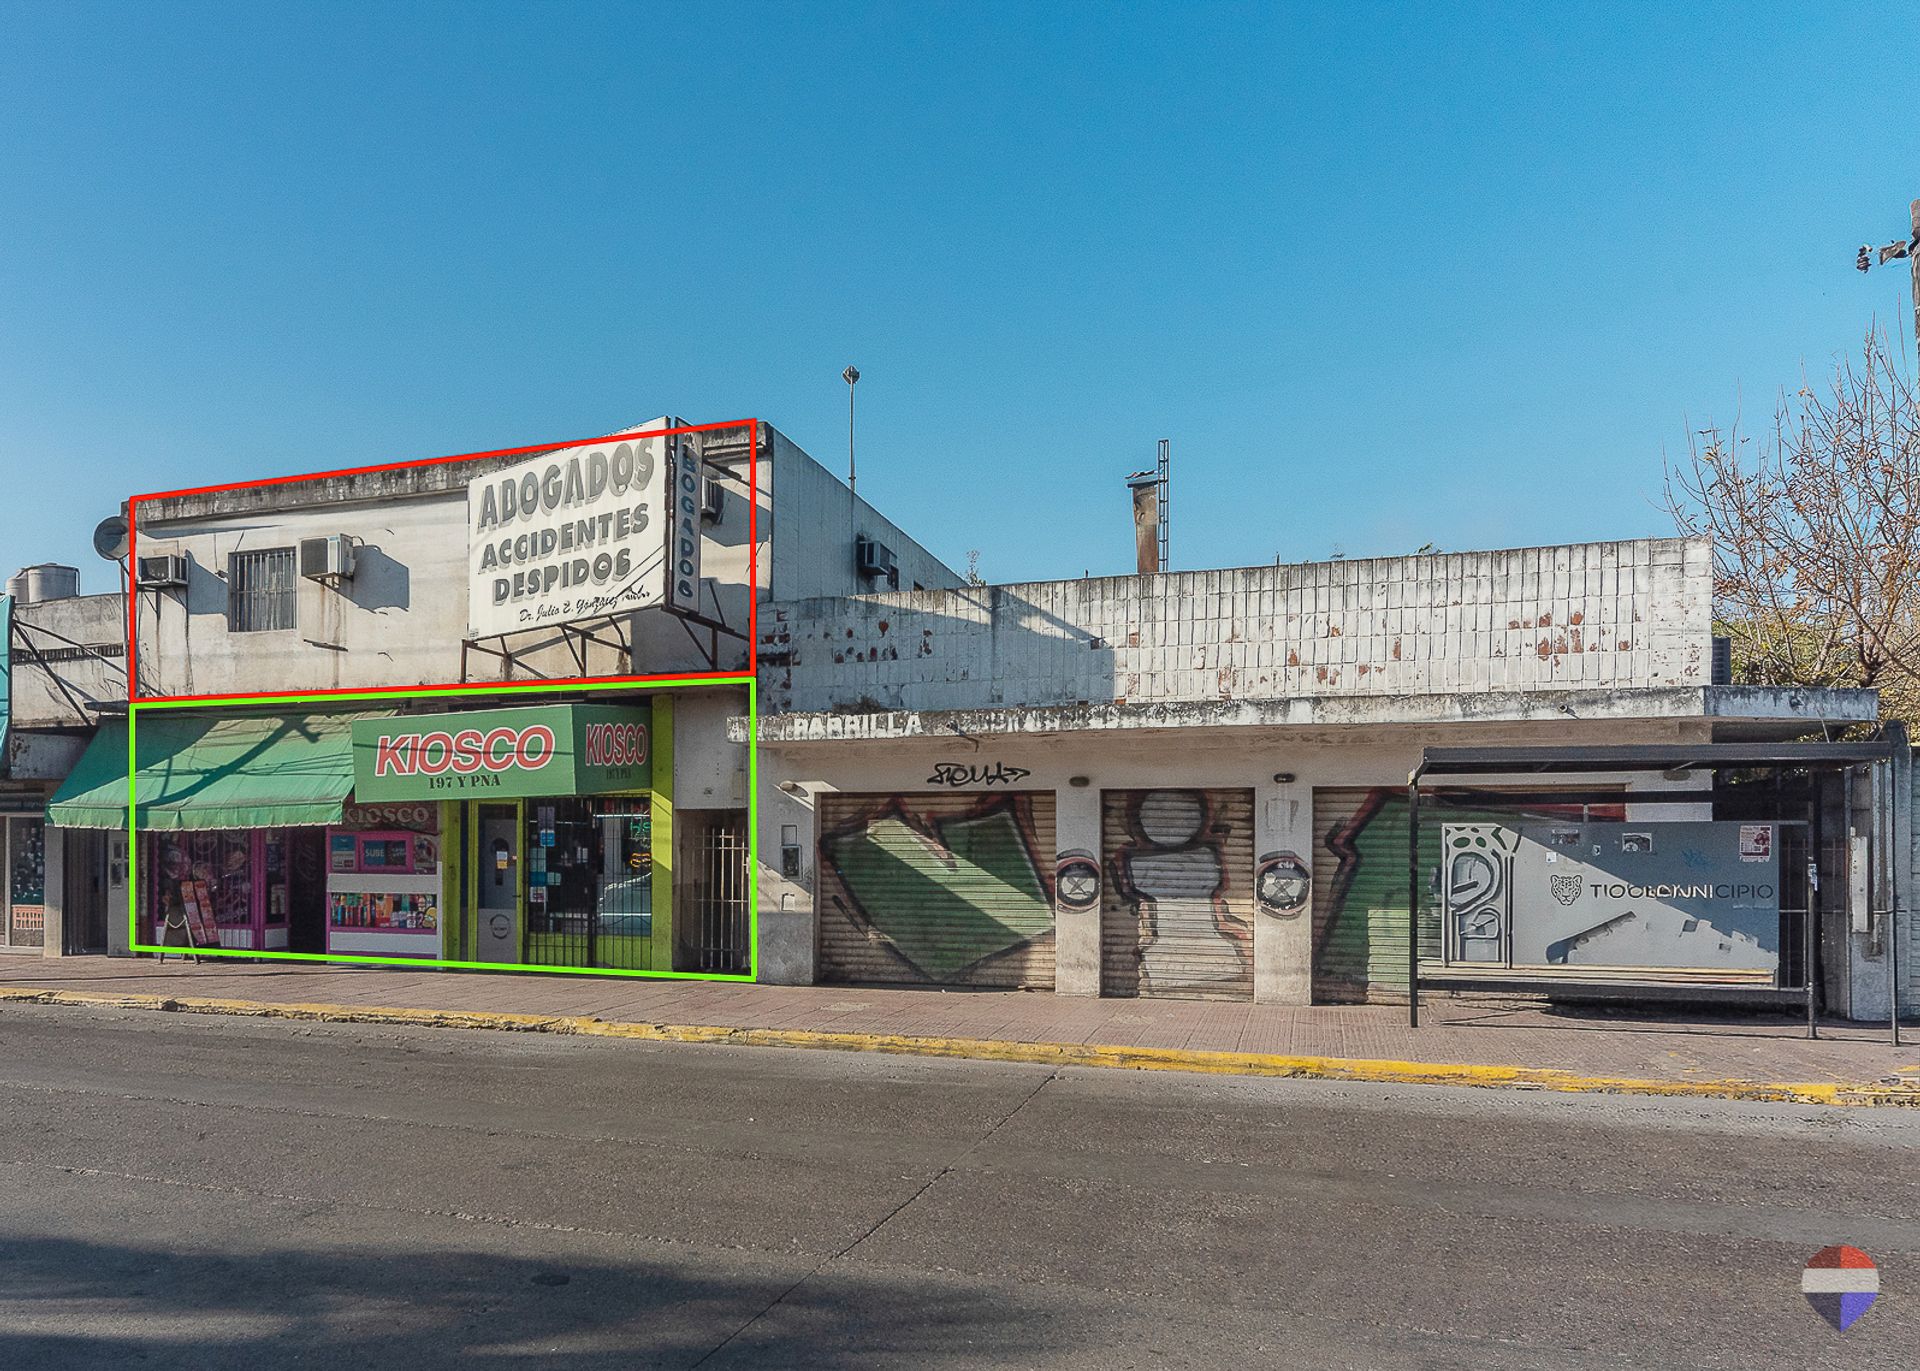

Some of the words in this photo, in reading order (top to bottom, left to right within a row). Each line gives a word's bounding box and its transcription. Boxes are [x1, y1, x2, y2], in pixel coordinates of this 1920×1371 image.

[479, 503, 649, 574] ACCIDENTES
[494, 548, 631, 605] DESPIDOS
[519, 608, 534, 622] Dr.
[536, 602, 560, 621] Julio
[375, 724, 556, 777] KIOSCO
[585, 723, 648, 767] KIOSCO
[429, 776, 453, 790] 197
[457, 775, 467, 788] Y
[470, 774, 501, 788] PNA
